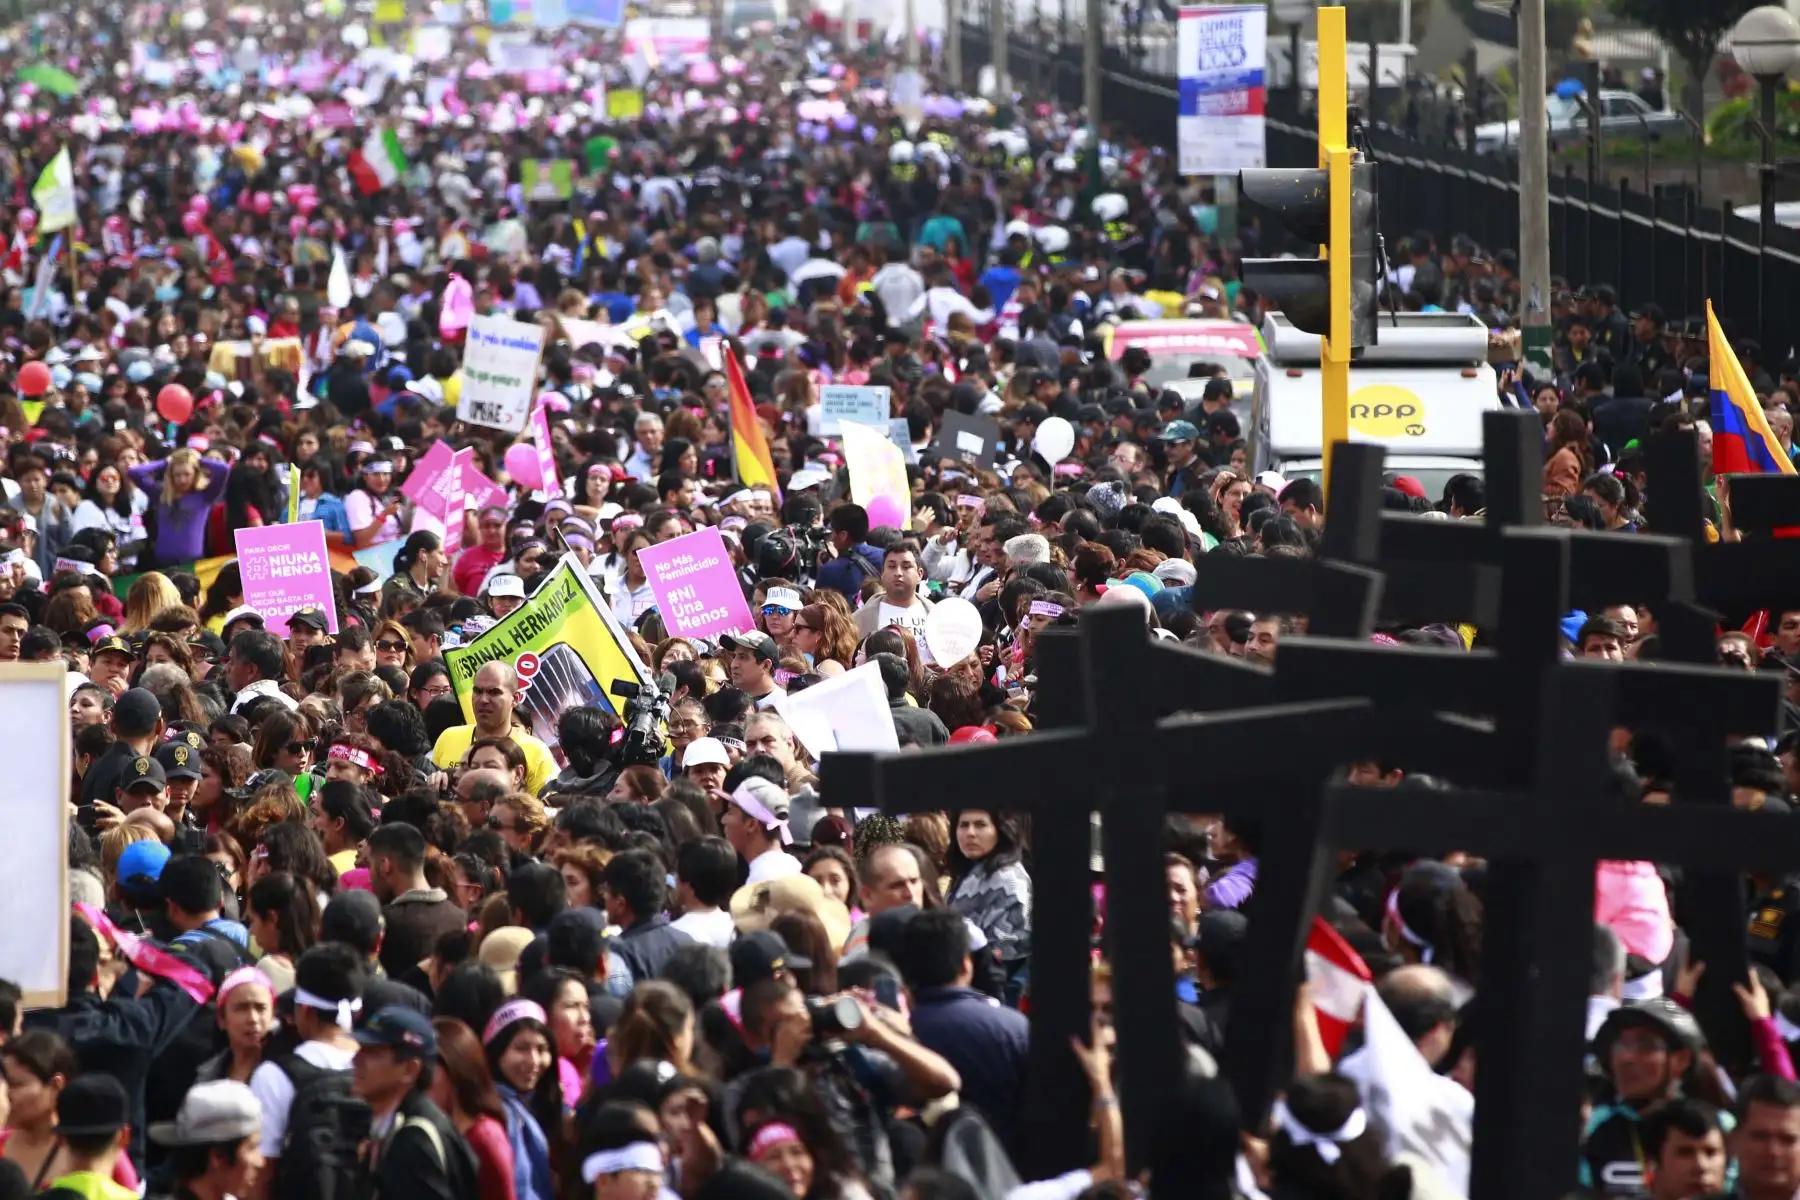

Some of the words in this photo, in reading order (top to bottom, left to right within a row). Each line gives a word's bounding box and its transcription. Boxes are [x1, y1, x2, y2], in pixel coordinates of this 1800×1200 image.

[244, 546, 265, 555] PARA
[267, 543, 291, 553] DECIR
[271, 562, 322, 578] MENOS
[655, 561, 671, 572] No
[303, 593, 315, 601] DE
[671, 600, 704, 618] Una
[675, 606, 729, 632] Menos
[890, 617, 904, 626] NI
